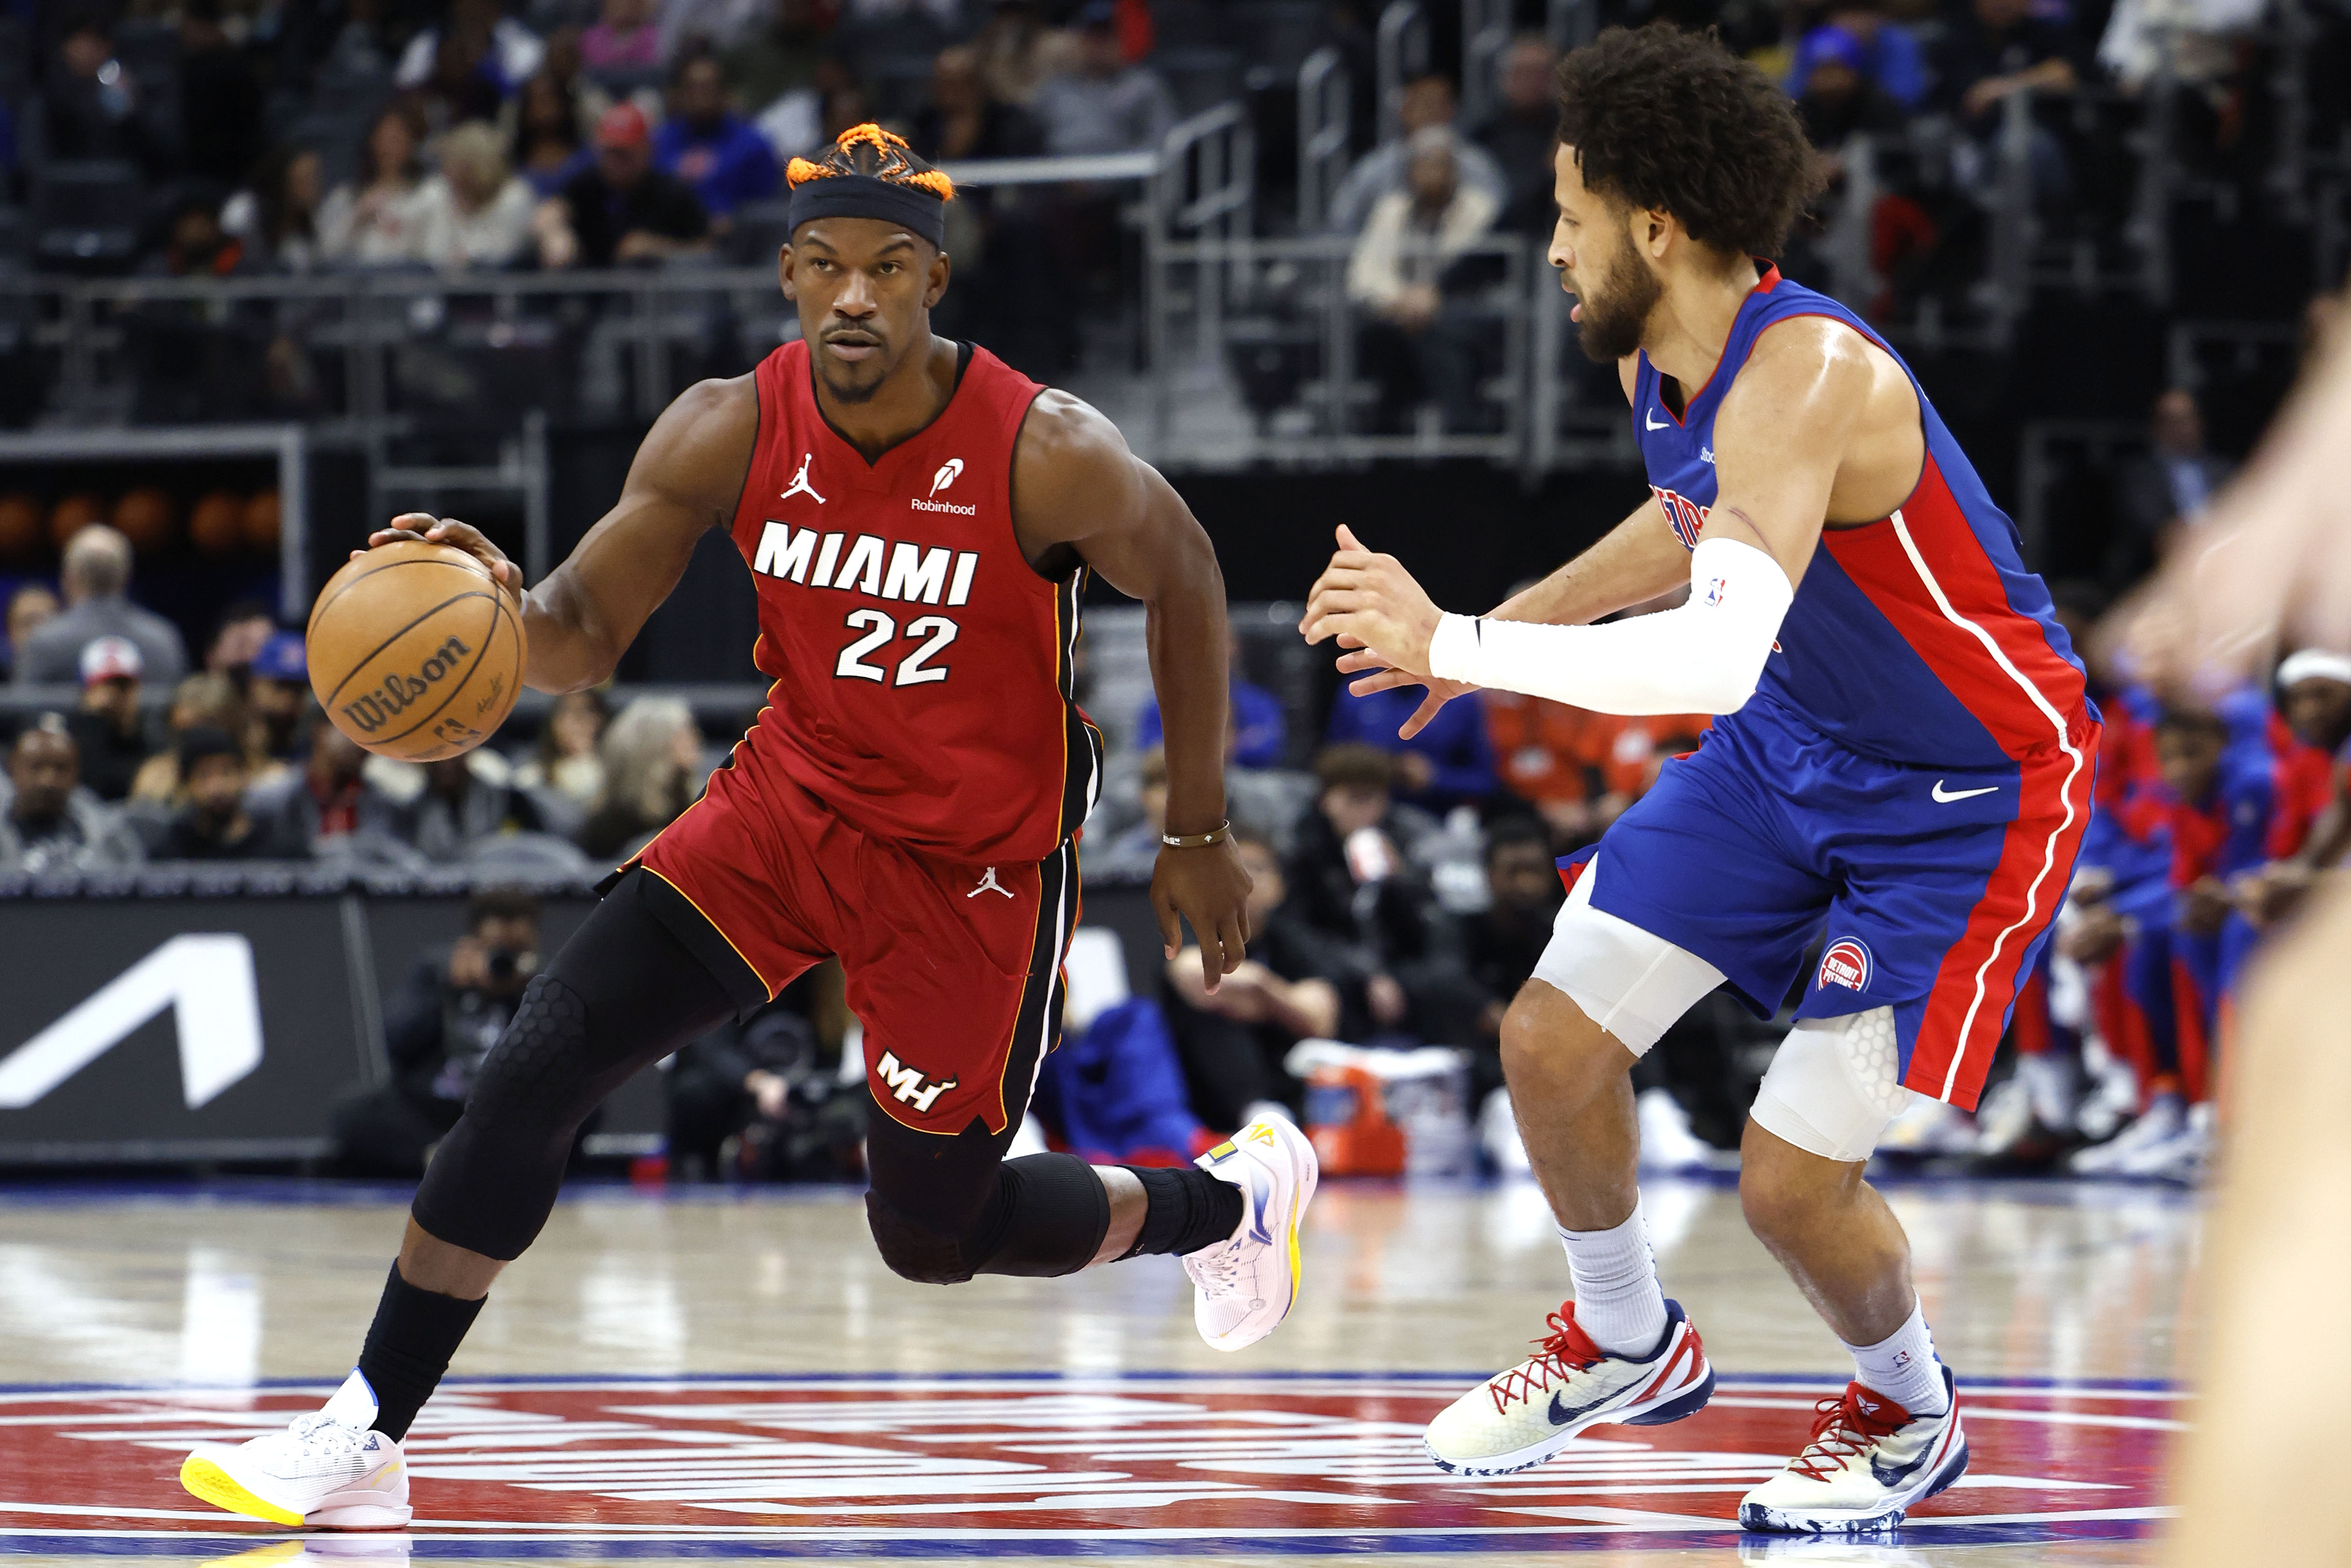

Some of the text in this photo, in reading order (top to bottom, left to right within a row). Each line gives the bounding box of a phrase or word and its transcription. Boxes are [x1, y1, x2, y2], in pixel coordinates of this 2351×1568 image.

[911, 498, 975, 516] Robinhood
[753, 519, 980, 607] MIAMI
[341, 635, 471, 733] Wilson
[833, 606, 961, 688] 22
[1828, 956, 1860, 982] DETROIT
